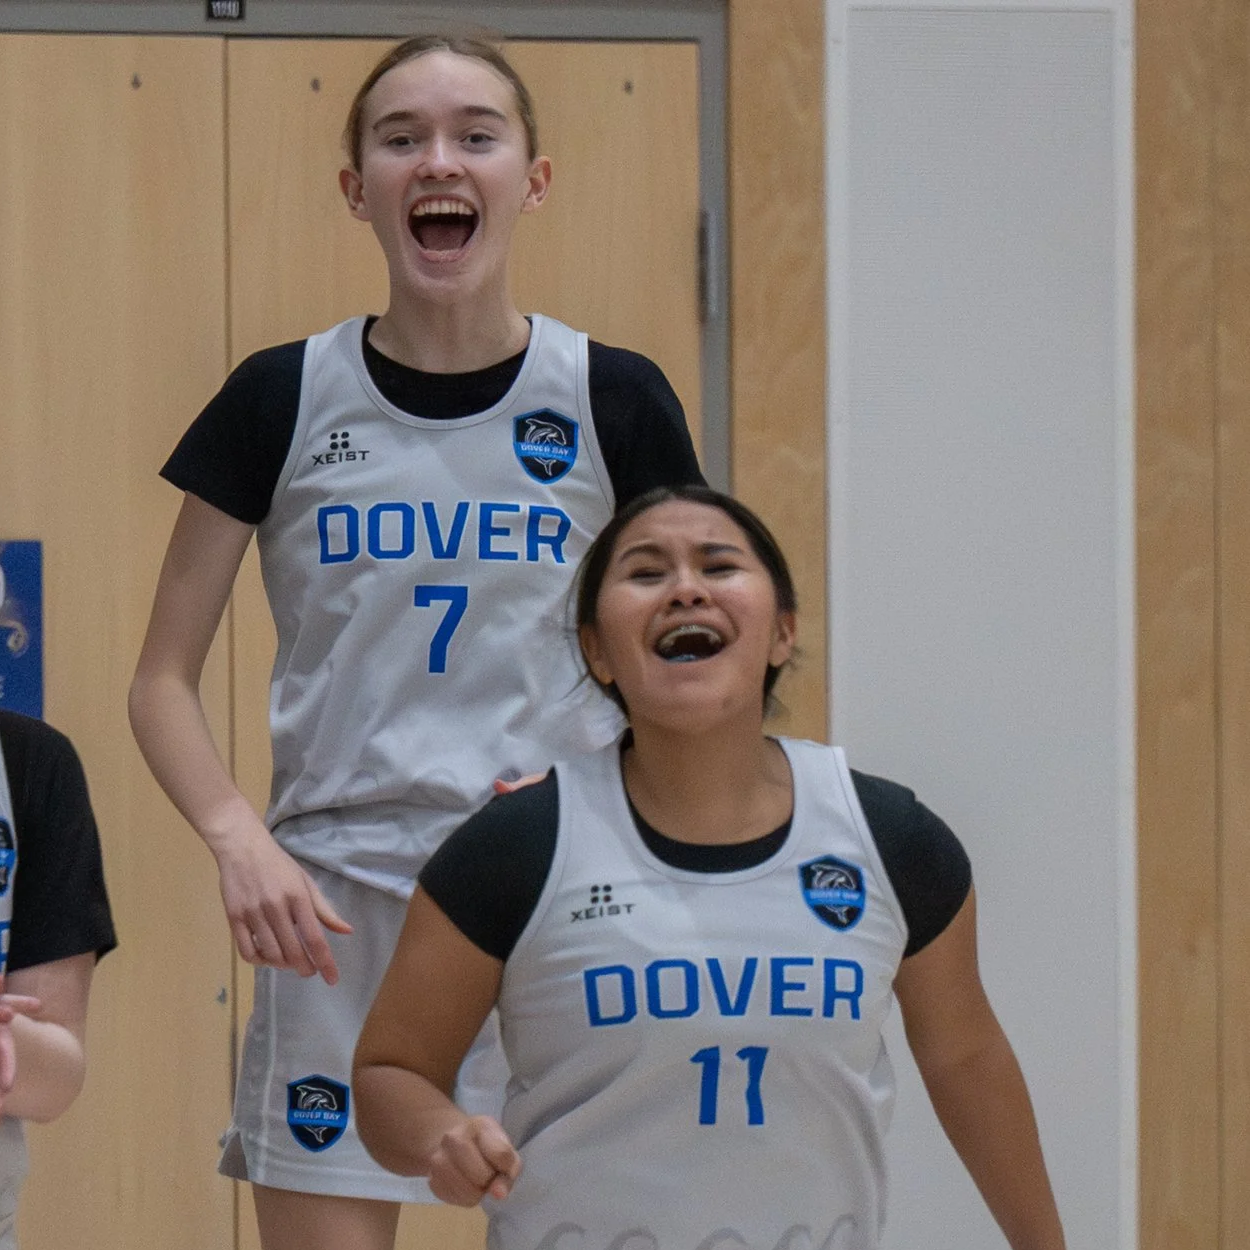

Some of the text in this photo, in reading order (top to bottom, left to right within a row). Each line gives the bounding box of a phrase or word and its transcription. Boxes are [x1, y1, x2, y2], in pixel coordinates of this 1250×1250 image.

[311, 450, 370, 467] XEIST
[317, 501, 572, 564] DOVER
[414, 585, 468, 673] 7
[570, 903, 636, 923] XEIST
[583, 957, 864, 1027] DOVER
[689, 1046, 769, 1126] 11
